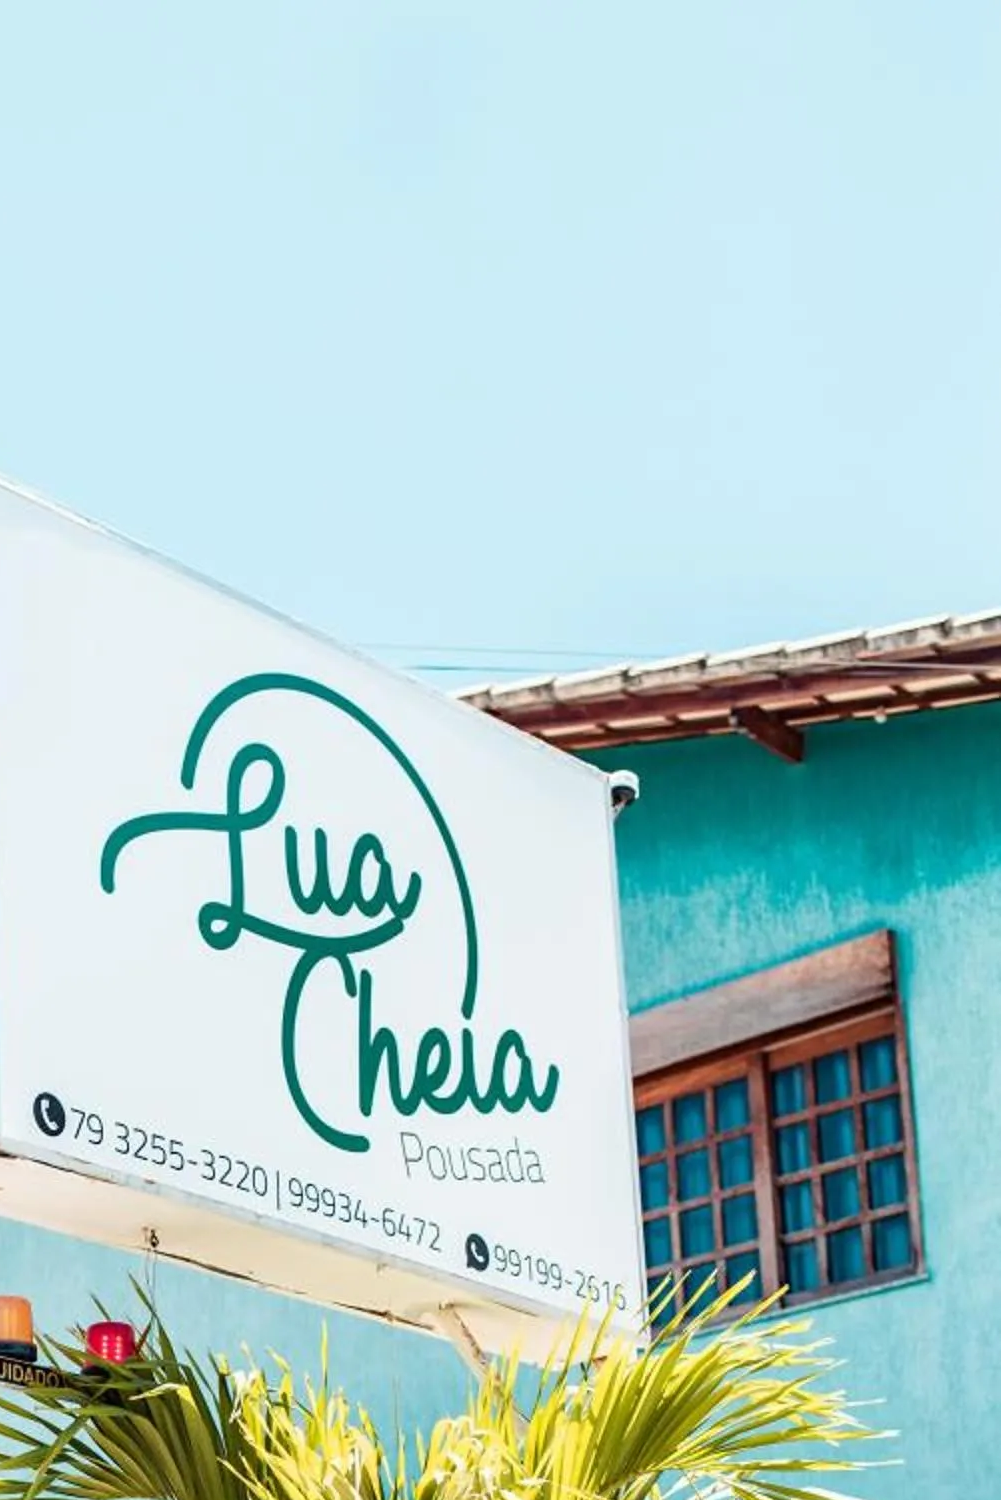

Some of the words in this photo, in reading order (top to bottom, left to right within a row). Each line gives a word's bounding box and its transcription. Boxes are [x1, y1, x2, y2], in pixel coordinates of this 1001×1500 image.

[100, 743, 421, 950] Lua
[282, 940, 559, 1152] Cheia
[70, 1107, 104, 1145] 79
[114, 1121, 268, 1197] 3255-3220
[288, 1177, 442, 1253] 99934-6472
[400, 1131, 545, 1183] Pousada
[494, 1244, 627, 1311] 99199-2616
